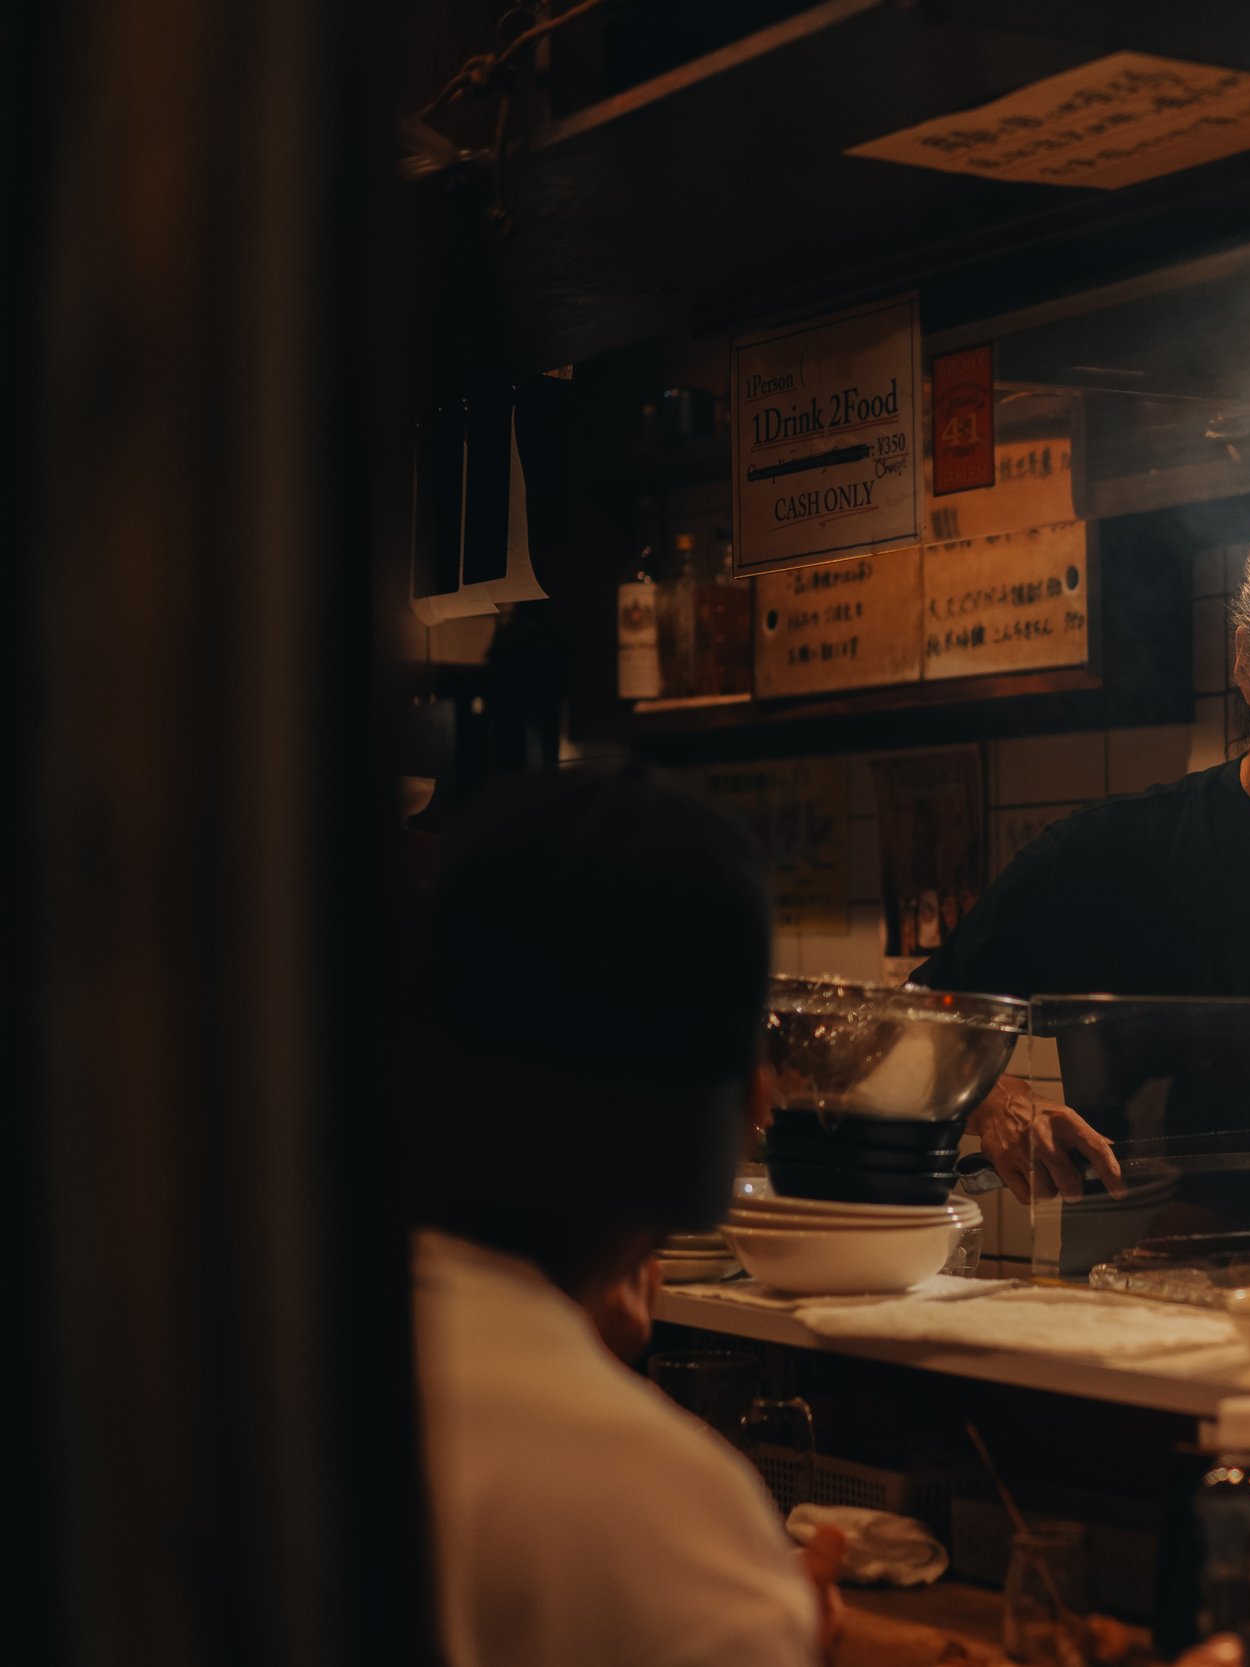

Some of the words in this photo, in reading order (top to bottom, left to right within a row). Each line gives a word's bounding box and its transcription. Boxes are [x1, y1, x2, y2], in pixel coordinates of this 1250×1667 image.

[745, 373, 795, 400] 1Person
[753, 396, 825, 446] 1Drink
[829, 377, 899, 428] 2Food
[940, 407, 980, 447] 41
[875, 431, 907, 457] ¥350
[774, 489, 821, 522] CASH
[824, 479, 876, 513] ONLY
